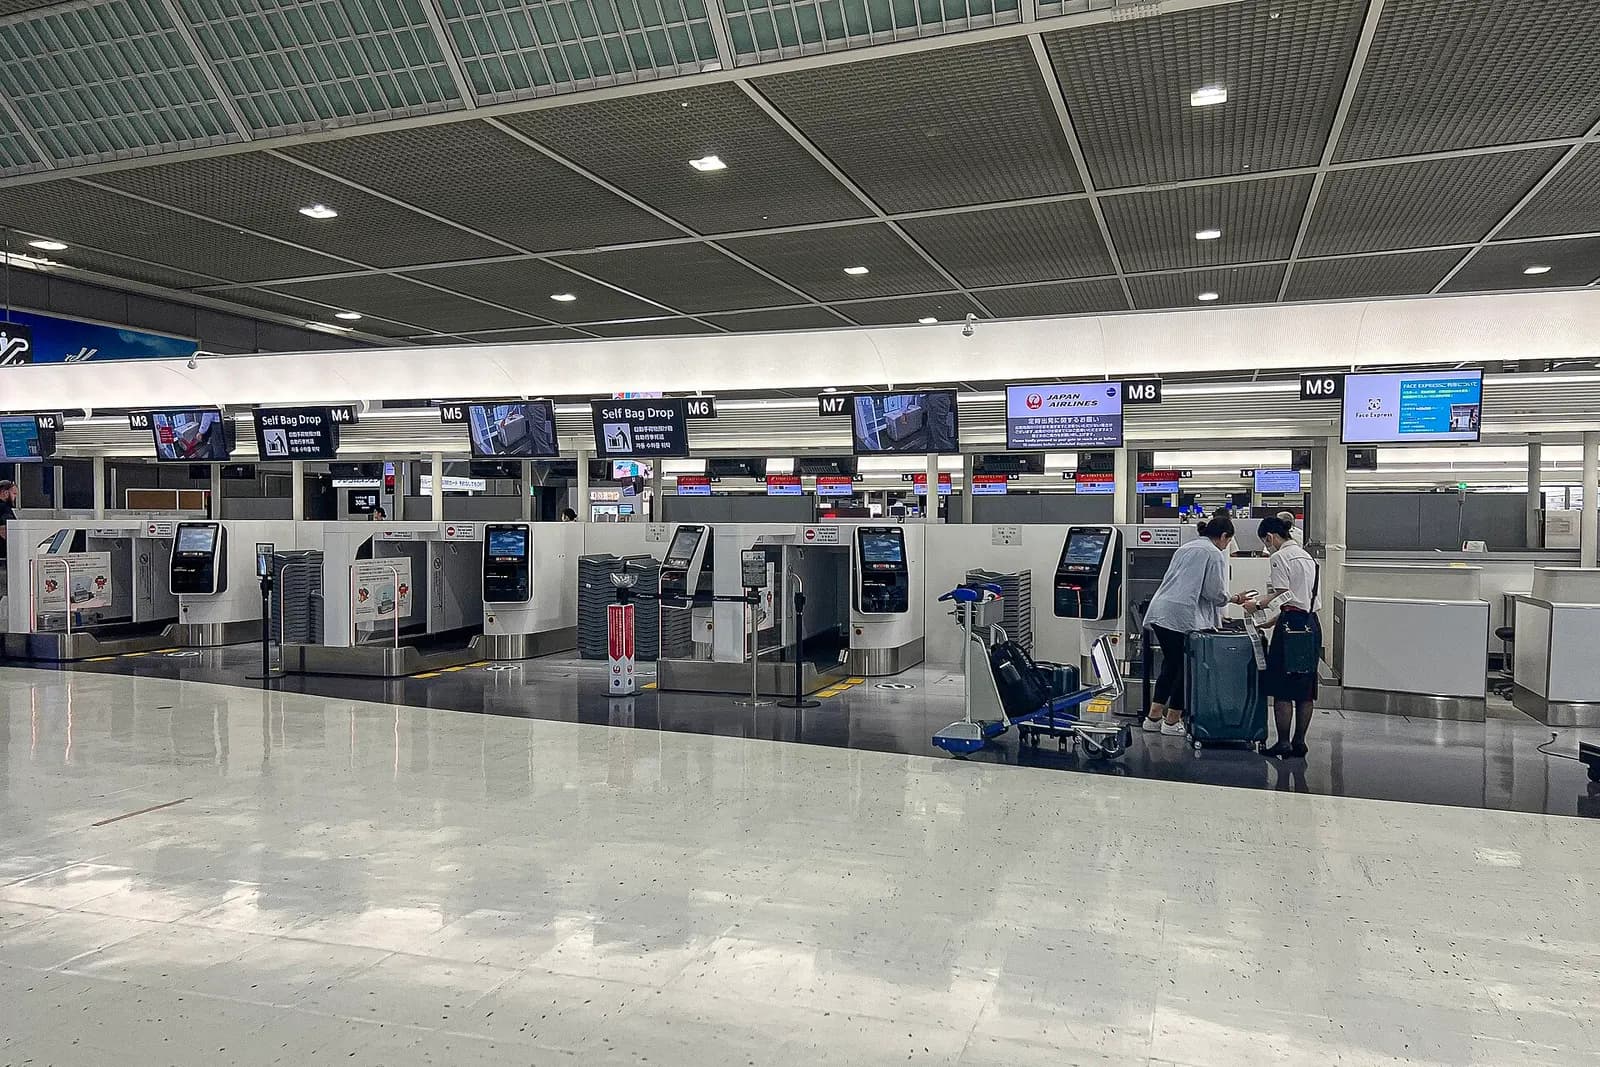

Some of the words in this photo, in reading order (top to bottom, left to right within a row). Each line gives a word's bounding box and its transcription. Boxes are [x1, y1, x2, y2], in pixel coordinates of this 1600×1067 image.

[1128, 384, 1156, 400] M8
[1306, 379, 1336, 395] M9
[1047, 393, 1081, 401] JAPAN
[687, 401, 709, 415] M6
[822, 398, 845, 412] M7
[1049, 400, 1098, 408] AIRLINES
[331, 409, 350, 421] M4
[443, 407, 463, 420] M5
[602, 408, 622, 419] Self
[624, 408, 645, 421] Bag
[647, 407, 674, 420] Drop
[39, 417, 55, 429] M2
[131, 415, 148, 427] M3
[262, 415, 279, 426] Self
[280, 415, 297, 427] Bag
[298, 414, 321, 426] Drop
